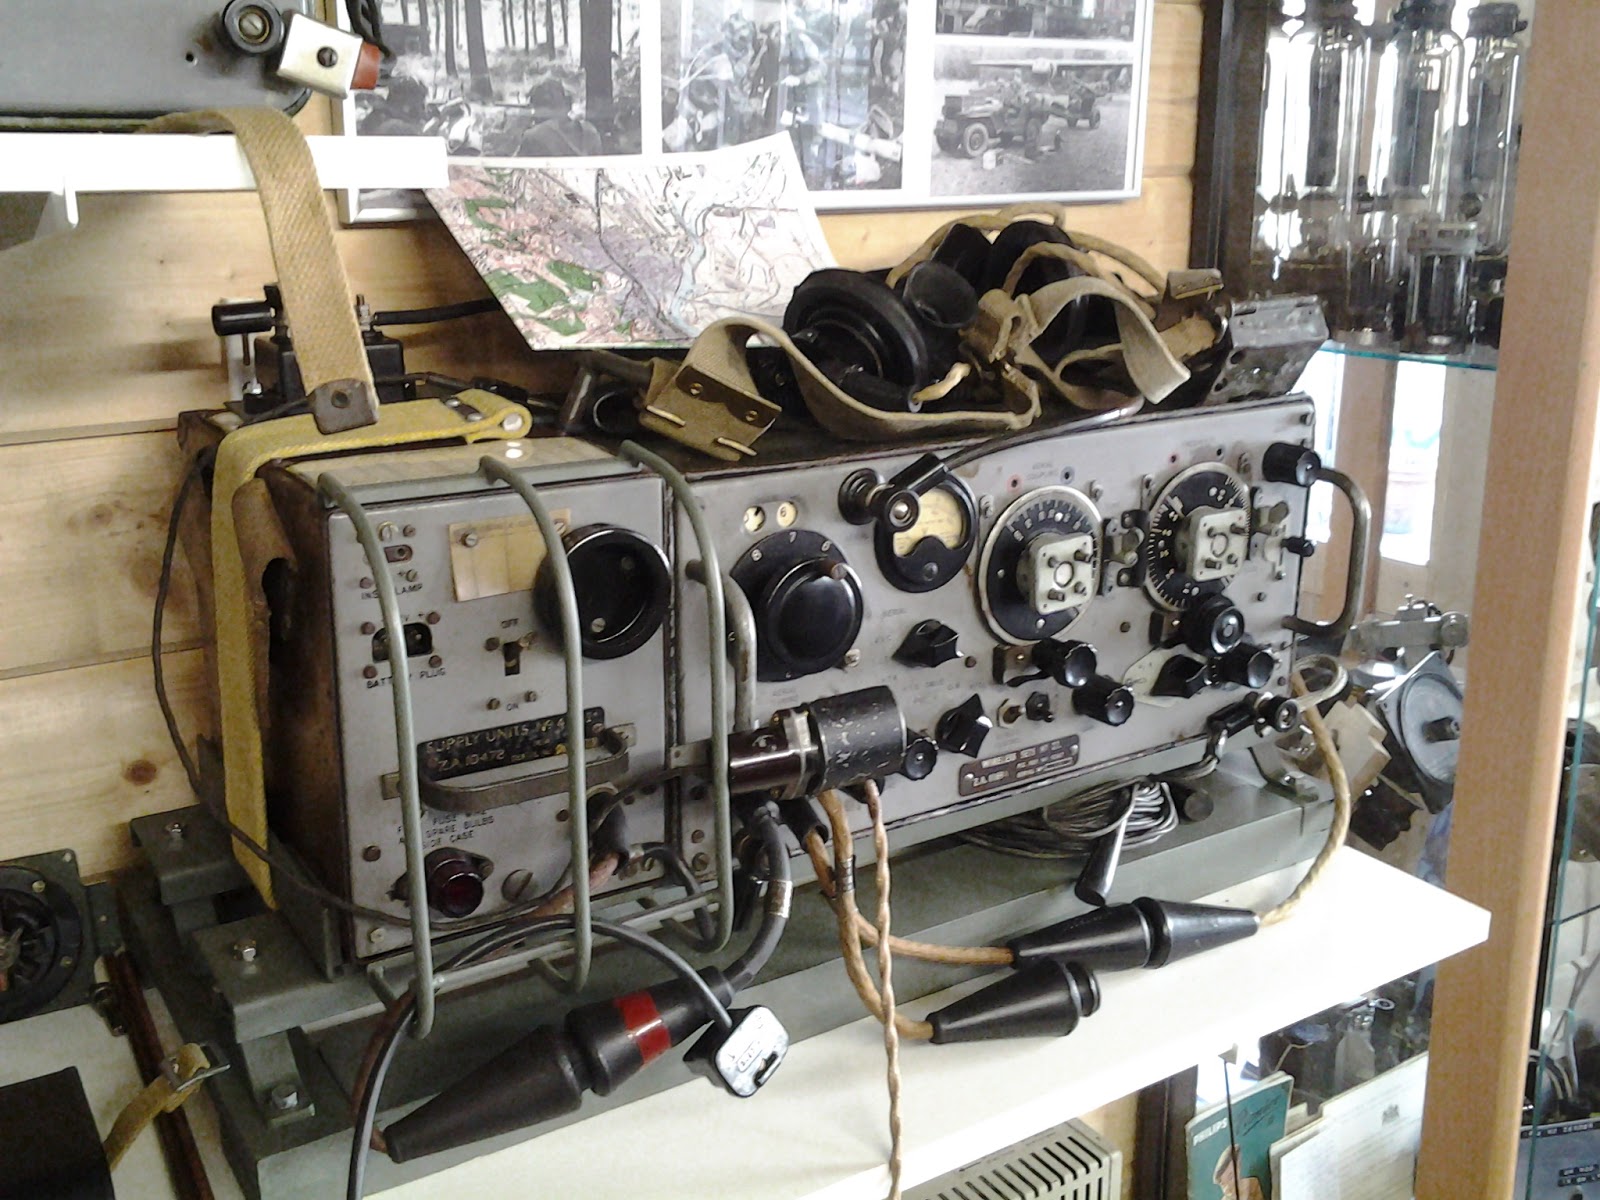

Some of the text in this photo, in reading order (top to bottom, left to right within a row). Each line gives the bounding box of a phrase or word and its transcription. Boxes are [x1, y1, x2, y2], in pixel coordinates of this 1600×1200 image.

[788, 531, 797, 543] 7
[420, 668, 446, 679] PLUG
[506, 703, 519, 711] ON
[426, 735, 479, 753] SUPPLY
[485, 724, 530, 742] UNITS
